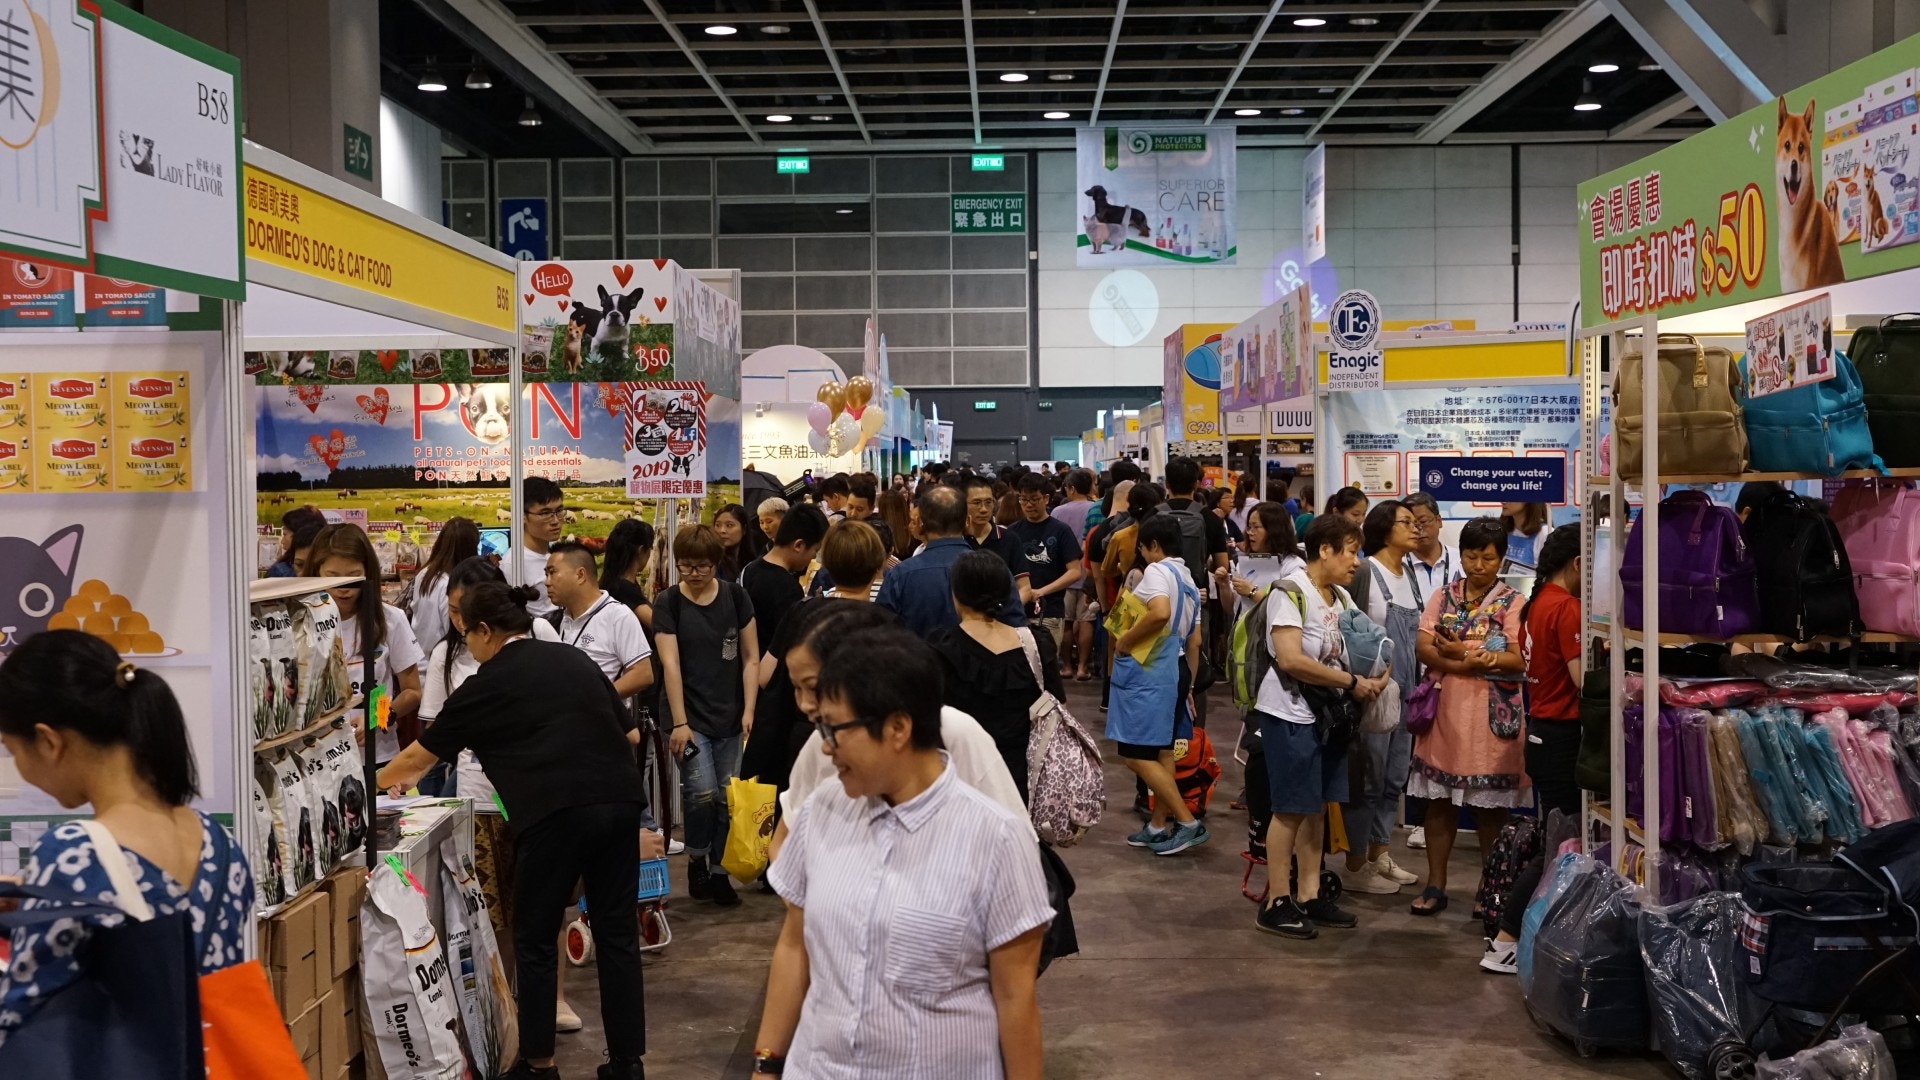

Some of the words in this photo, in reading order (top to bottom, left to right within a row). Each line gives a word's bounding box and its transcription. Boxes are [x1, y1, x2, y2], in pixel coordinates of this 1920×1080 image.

[197, 82, 229, 124] B58
[1154, 135, 1202, 144] NATURE'S
[778, 160, 798, 170] EXIT
[973, 158, 992, 167] EXIT
[186, 163, 224, 197] FLAVOR
[1158, 179, 1225, 190] SUPERIOR
[247, 176, 300, 224] 德國歌美奧
[954, 198, 1003, 210] EMERGENCY
[1005, 198, 1022, 209] EXIT
[1158, 192, 1225, 212] CARE
[1590, 170, 1661, 243] 會場優惠
[954, 212, 1022, 228] 緊急出口
[1701, 184, 1766, 295] $50
[247, 218, 310, 264] DORMEO'S
[313, 239, 335, 272] DOG
[338, 248, 345, 274] &
[347, 252, 365, 279] CAT
[367, 259, 392, 288] FOOD
[1601, 220, 1696, 315] 即時扣減
[536, 272, 570, 290] HELLO
[496, 285, 509, 311] B56
[635, 347, 670, 372] B50
[1329, 352, 1379, 372] Enagic
[1329, 372, 1378, 380] INDEPENDENT
[1329, 380, 1379, 389] DISTRIBUTOR
[45, 402, 72, 410] MEOW
[74, 402, 100, 410] LABEL
[1187, 422, 1215, 434] C29
[414, 446, 582, 457] PETS-ON-NTURAL
[742, 444, 826, 460] 三文魚油
[47, 462, 74, 470] MEOW
[416, 458, 428, 466] all
[430, 458, 463, 467] natural
[466, 459, 487, 468] pets
[522, 458, 534, 466] nd
[536, 458, 582, 466] essentials
[632, 460, 670, 480] 2019
[415, 470, 446, 480] PON
[1450, 468, 1489, 478] Change
[1492, 470, 1516, 478] your
[1518, 468, 1552, 478] water,
[630, 480, 703, 494] 寵物展限定優惠
[1461, 481, 1498, 491] change
[1500, 482, 1520, 492] you
[1522, 482, 1542, 490] life!
[392, 1002, 418, 1068] Dormeo's
